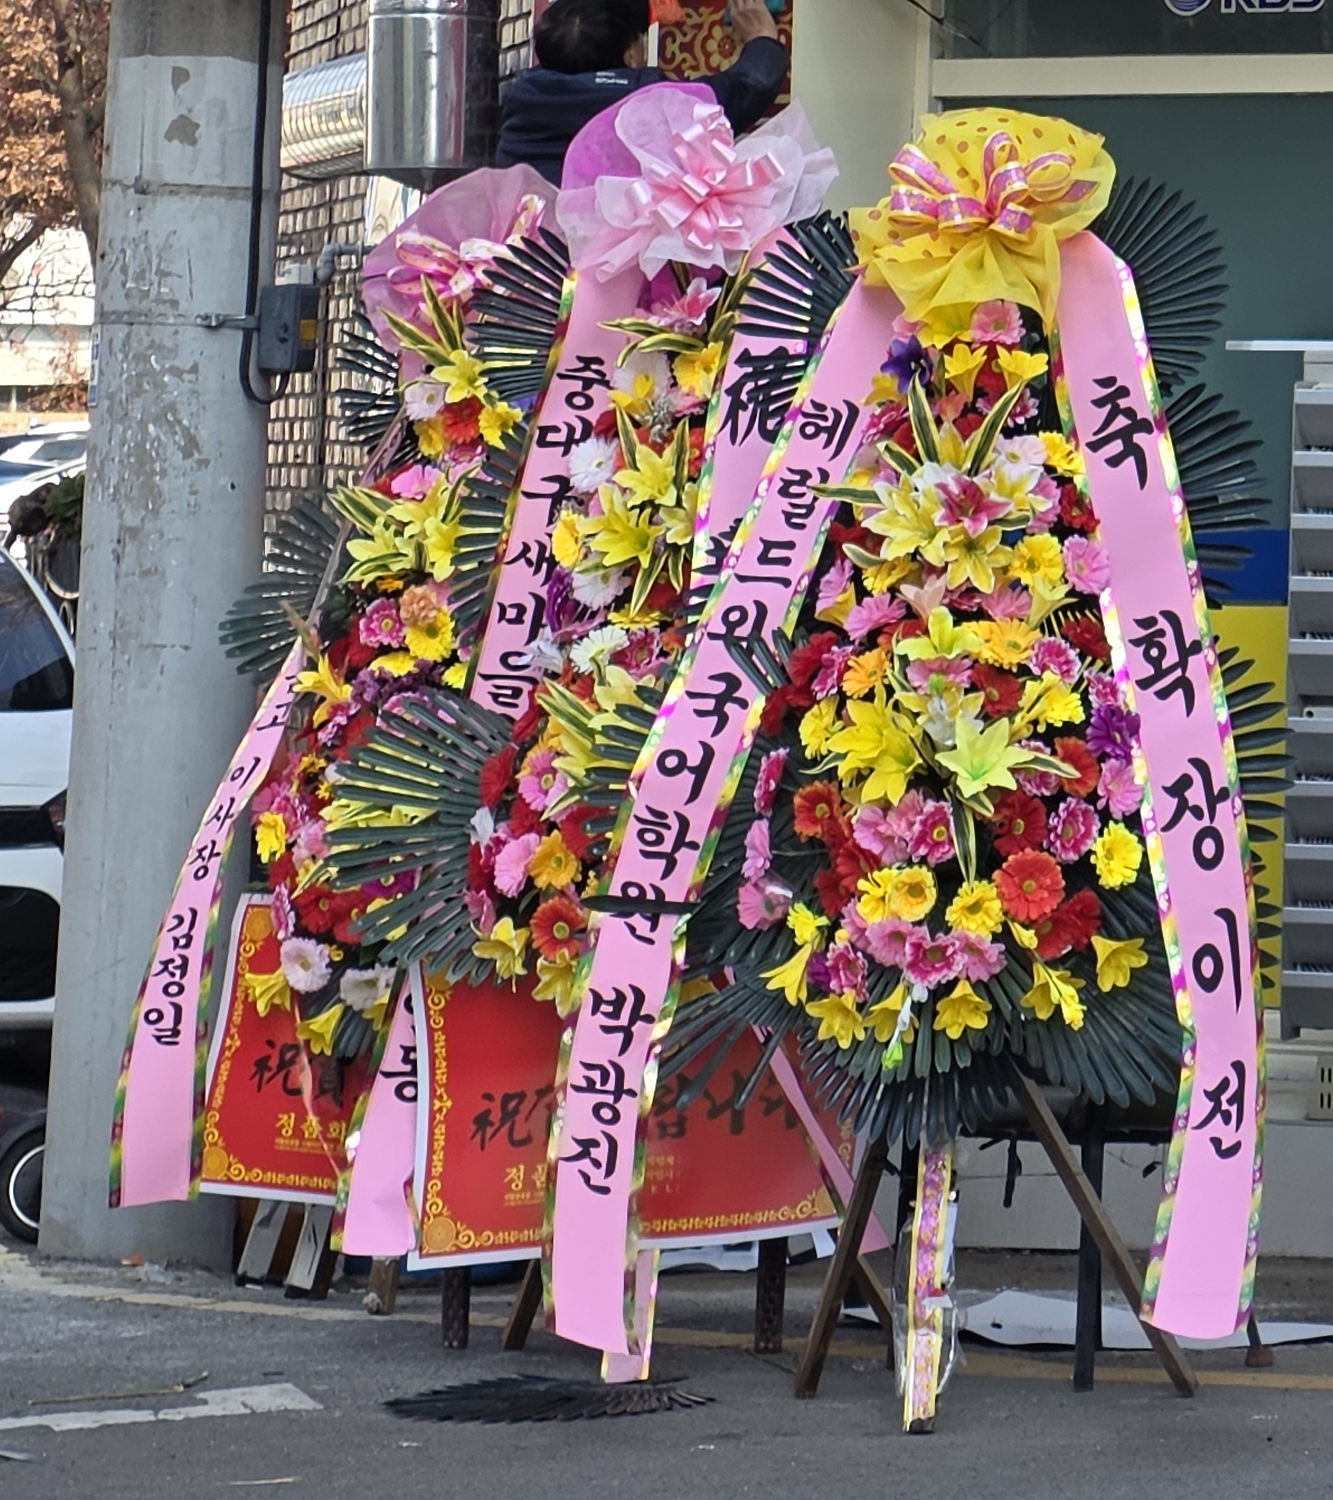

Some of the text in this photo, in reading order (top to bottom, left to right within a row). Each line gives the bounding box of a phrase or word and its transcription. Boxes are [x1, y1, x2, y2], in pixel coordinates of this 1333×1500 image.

[1085, 376, 1155, 491] 축
[188, 756, 262, 882] 이사장
[143, 906, 202, 1047] 김정일
[470, 1090, 534, 1152] 祝
[559, 983, 656, 1196] 박광진
